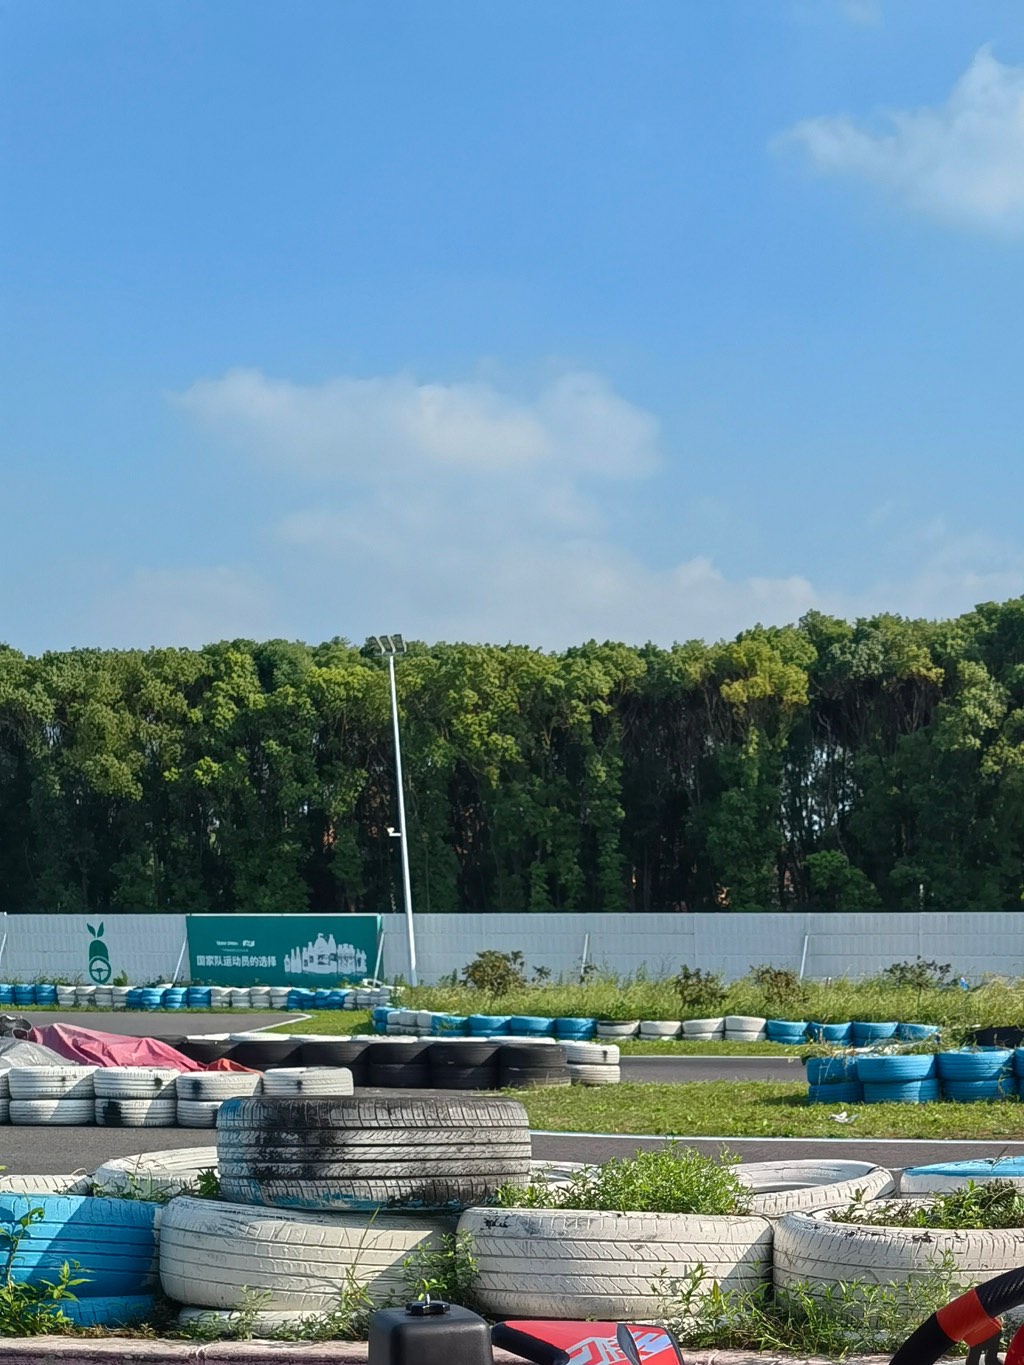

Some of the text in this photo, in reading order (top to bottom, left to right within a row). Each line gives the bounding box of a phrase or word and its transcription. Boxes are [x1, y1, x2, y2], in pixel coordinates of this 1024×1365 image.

[196, 955, 277, 967] 国家队运动员的选择
